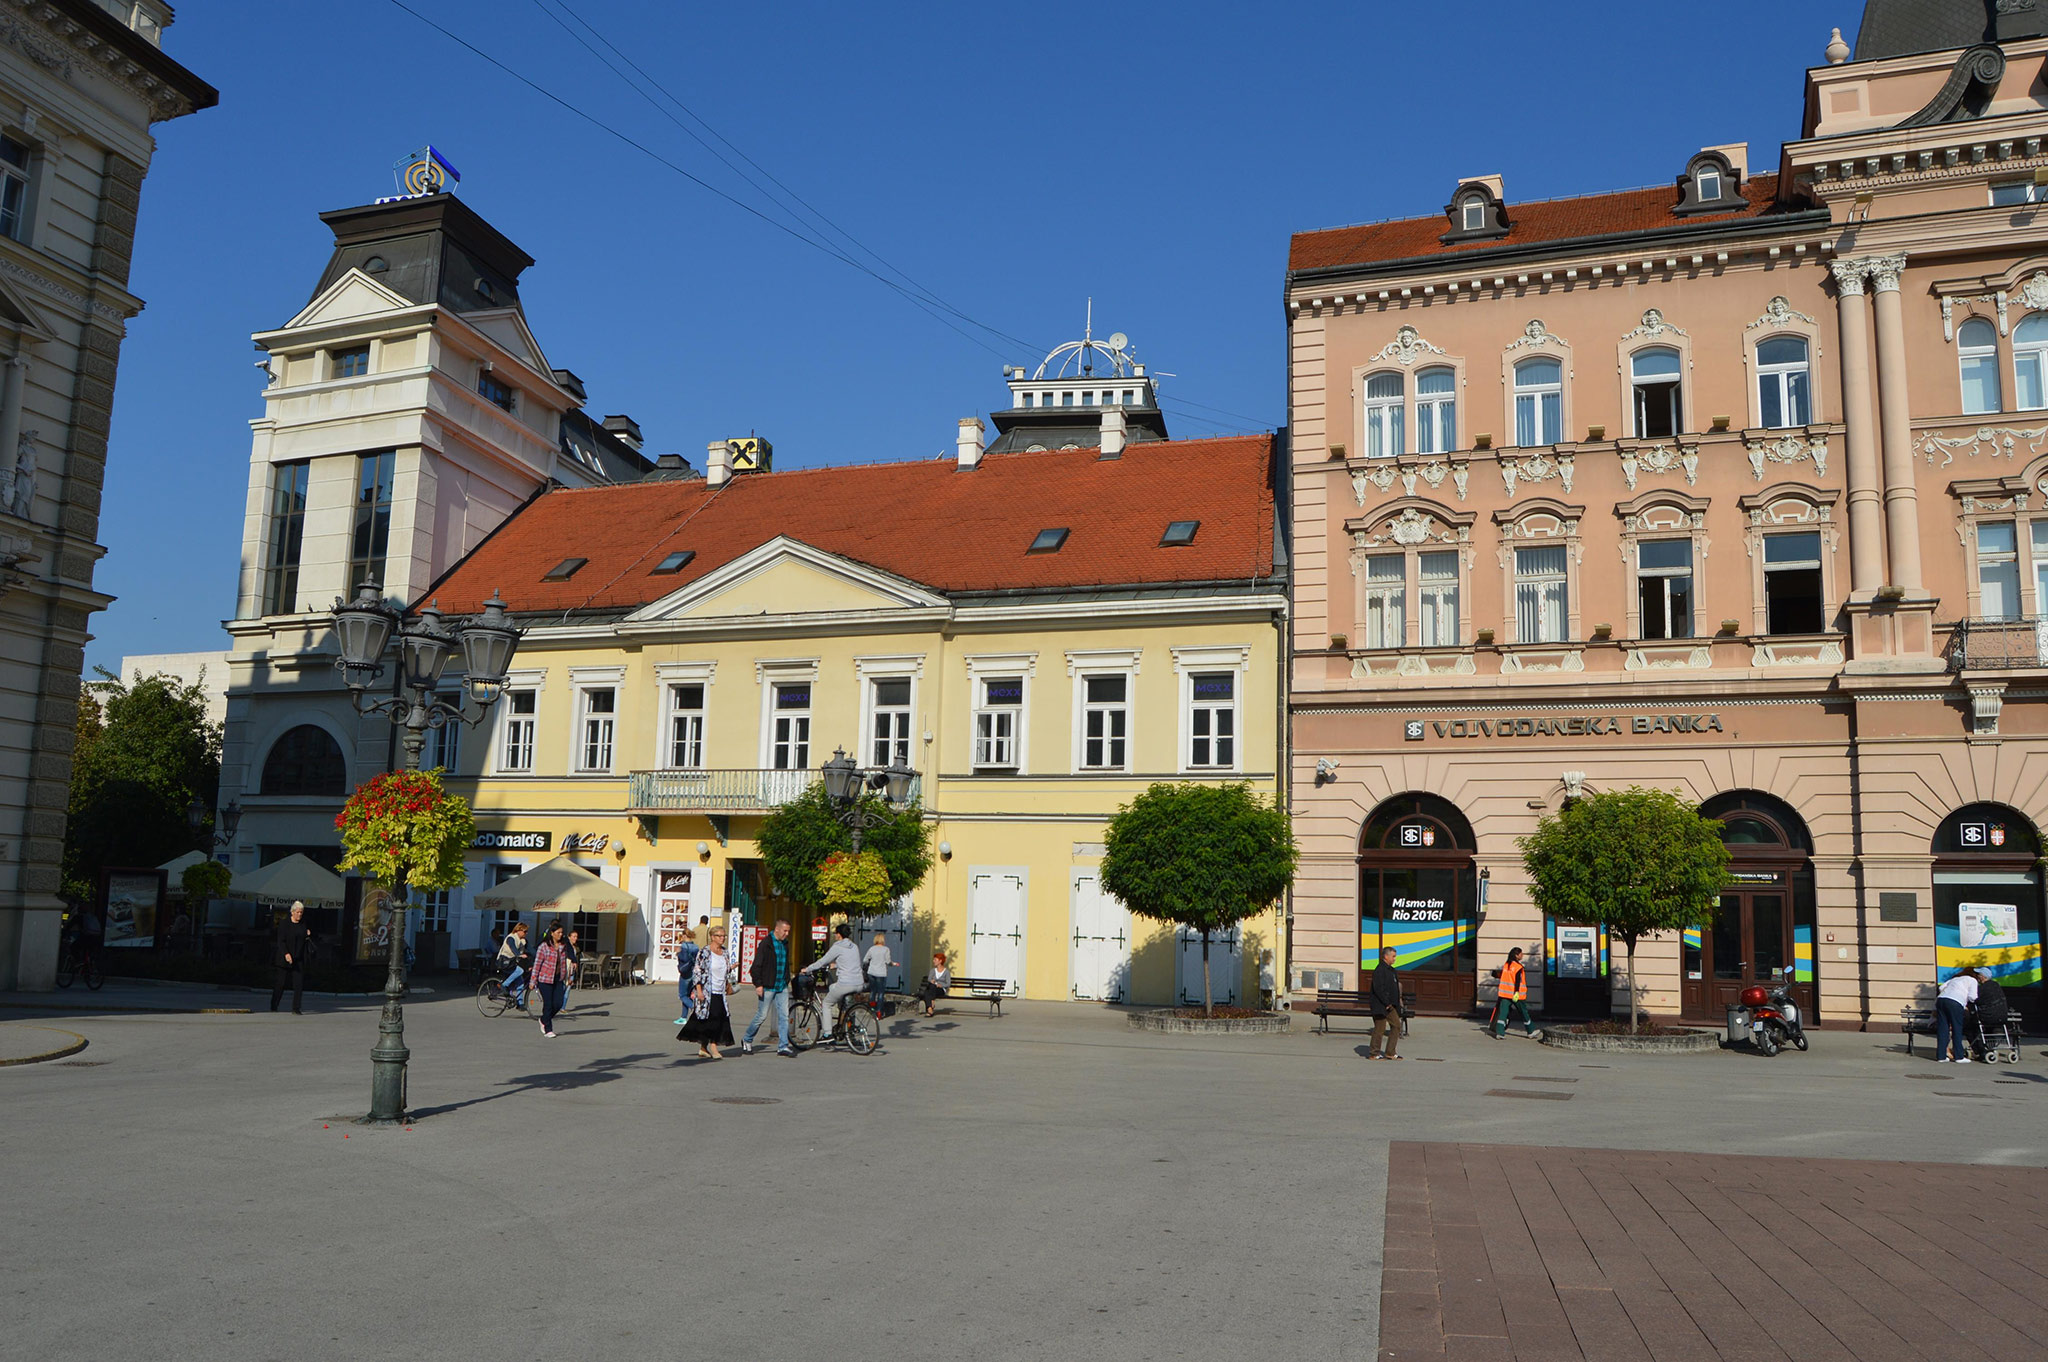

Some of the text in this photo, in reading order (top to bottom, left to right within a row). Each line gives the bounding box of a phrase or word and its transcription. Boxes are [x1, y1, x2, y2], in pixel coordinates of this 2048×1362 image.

[1432, 714, 1724, 738] VOJVOĐANSKA BANKA
[1392, 898, 1444, 908] Mi smo tim
[1392, 910, 1443, 921] Rio 2016!
